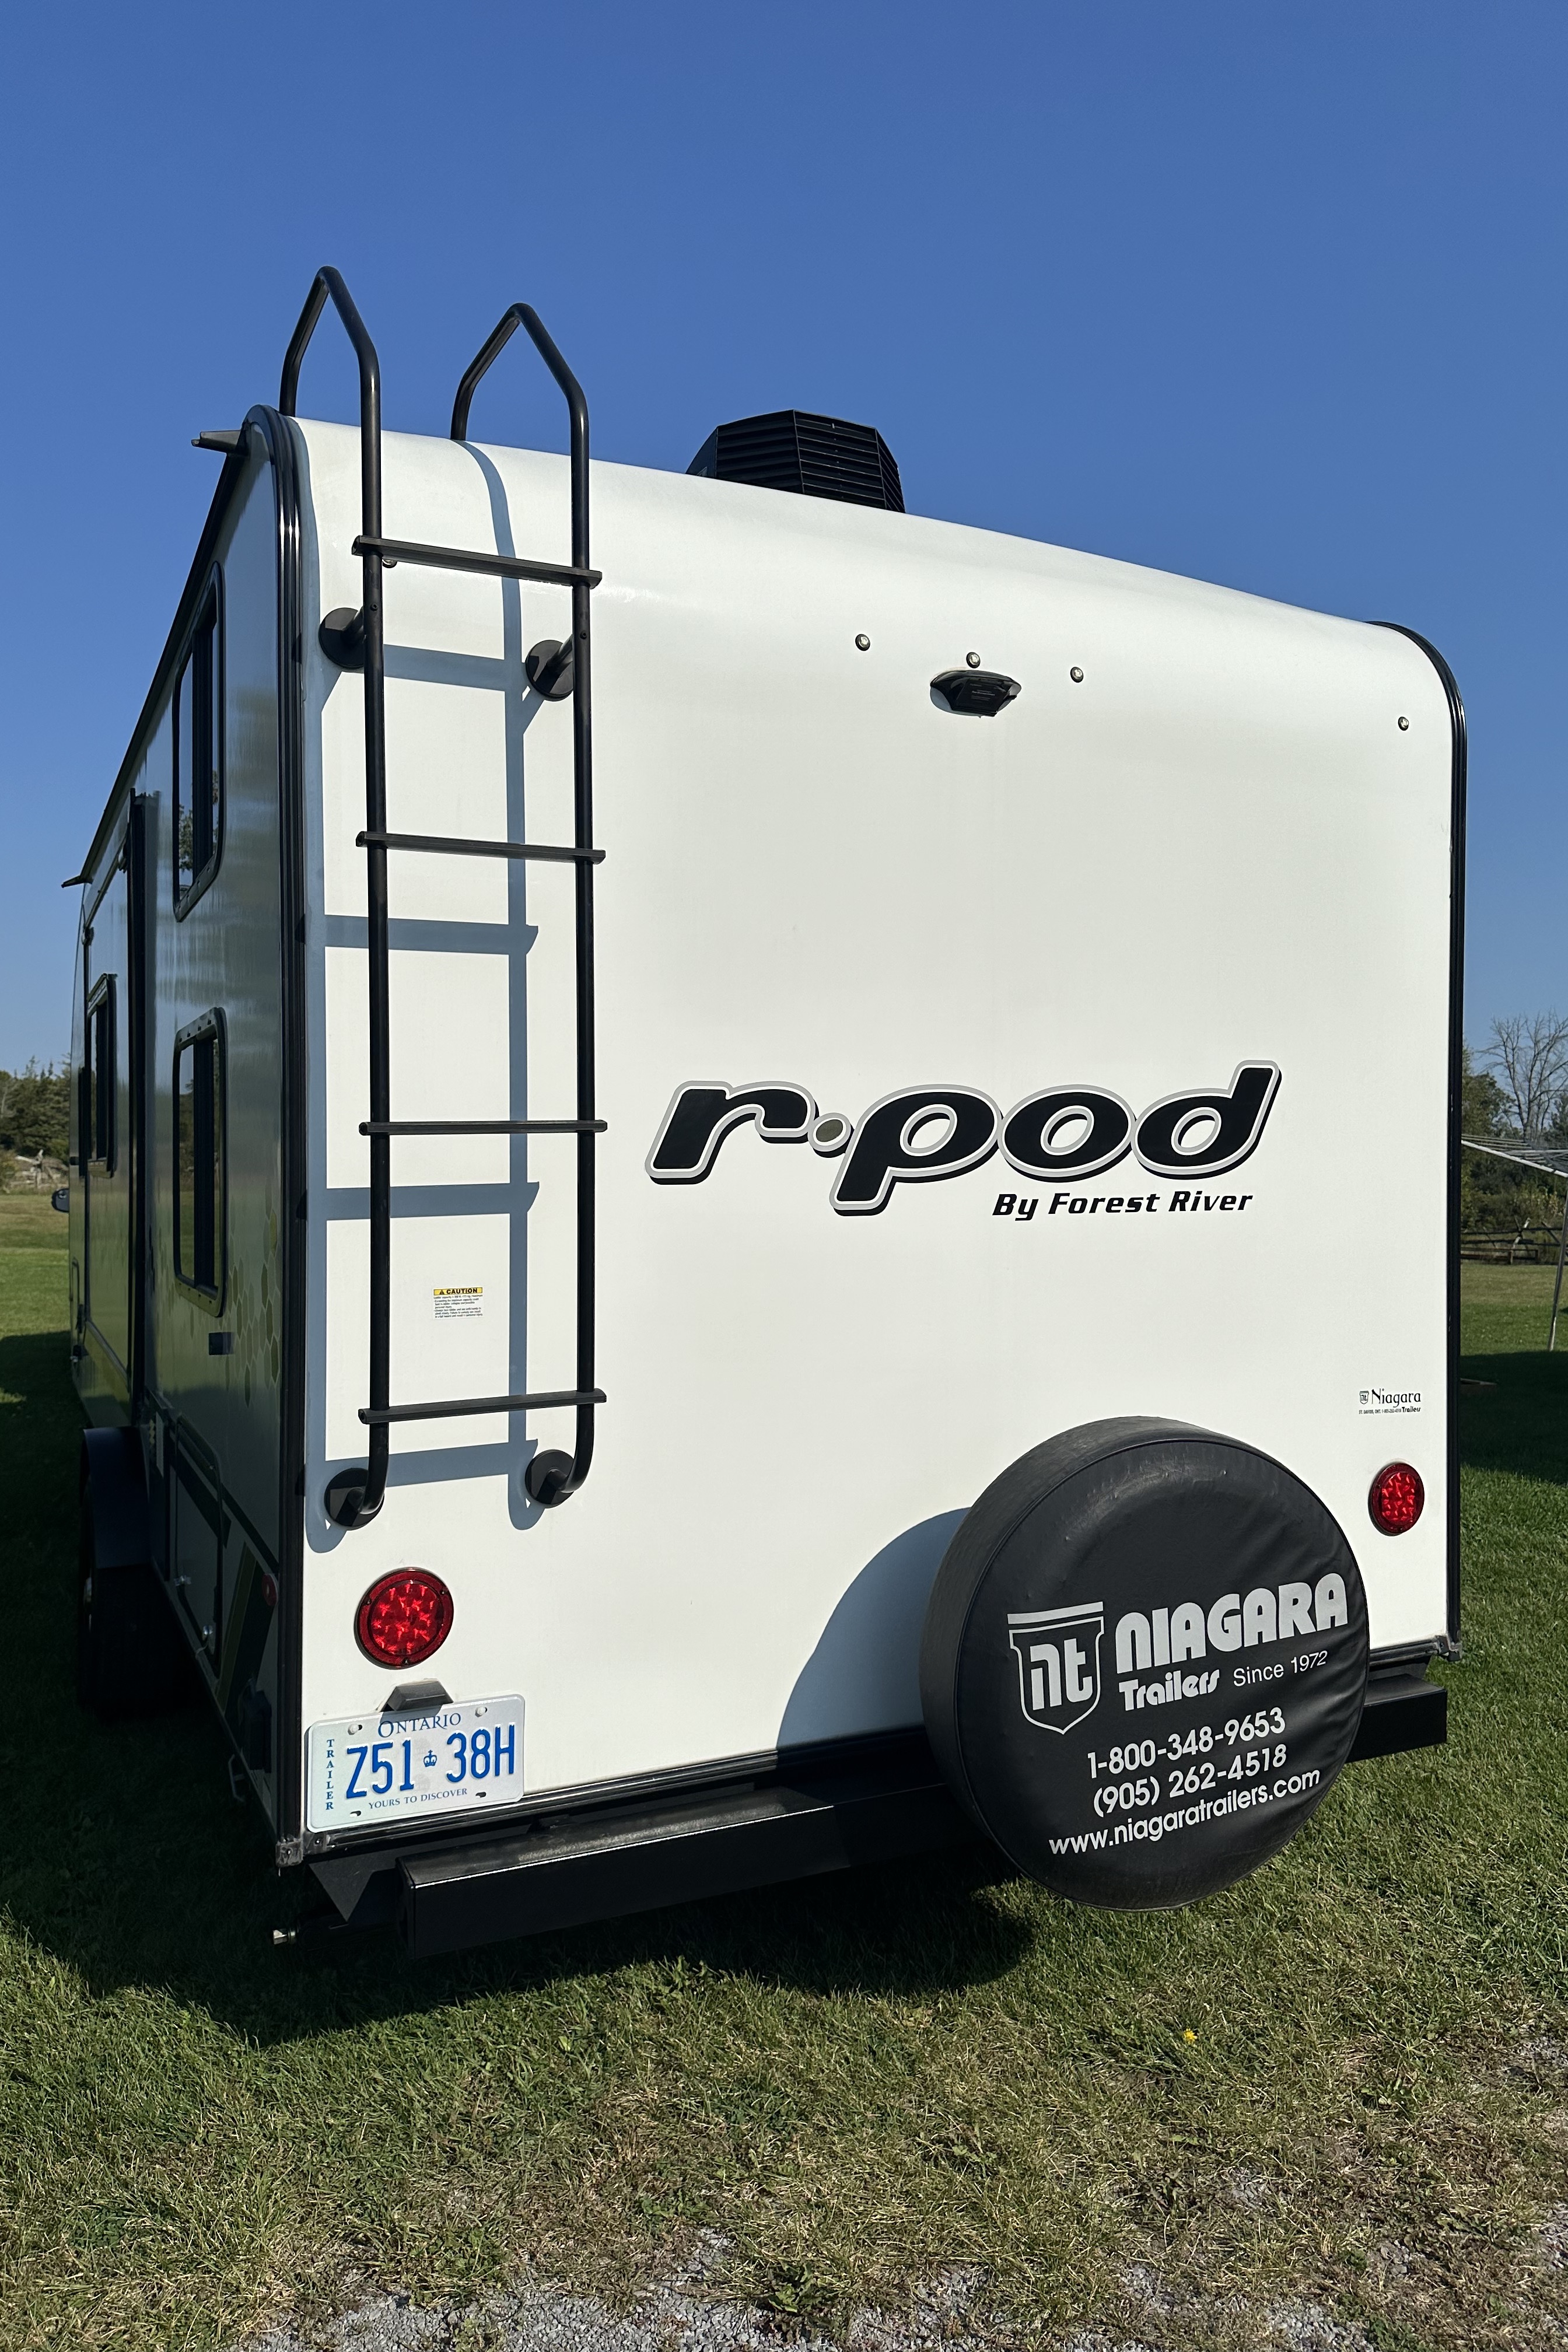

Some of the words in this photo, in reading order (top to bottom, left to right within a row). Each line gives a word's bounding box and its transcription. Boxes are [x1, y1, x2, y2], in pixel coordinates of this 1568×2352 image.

[992, 1194, 1038, 1221] By
[1048, 1192, 1160, 1214] Forest
[1168, 1190, 1253, 1212] River
[1371, 1388, 1421, 1408] Niagara
[1115, 1573, 1348, 1674] NIAGARA
[1119, 1670, 1220, 1712] Trailers
[1233, 1662, 1284, 1687] Since
[1291, 1650, 1328, 1675] 1972
[346, 1737, 415, 1800] Z51
[446, 1721, 516, 1783] 38H
[377, 1713, 462, 1738] ONTARIO
[1087, 1707, 1286, 1779] 1-800-348-9653
[326, 1739, 335, 1811] TRAILER
[369, 1798, 401, 1810] YOURS
[404, 1796, 418, 1804] TO
[420, 1788, 468, 1803] DISCOVER
[1093, 1776, 1160, 1818] (905)
[1168, 1744, 1287, 1798] 262-4518
[1049, 1769, 1321, 1855] www.niagaratrailers.com
